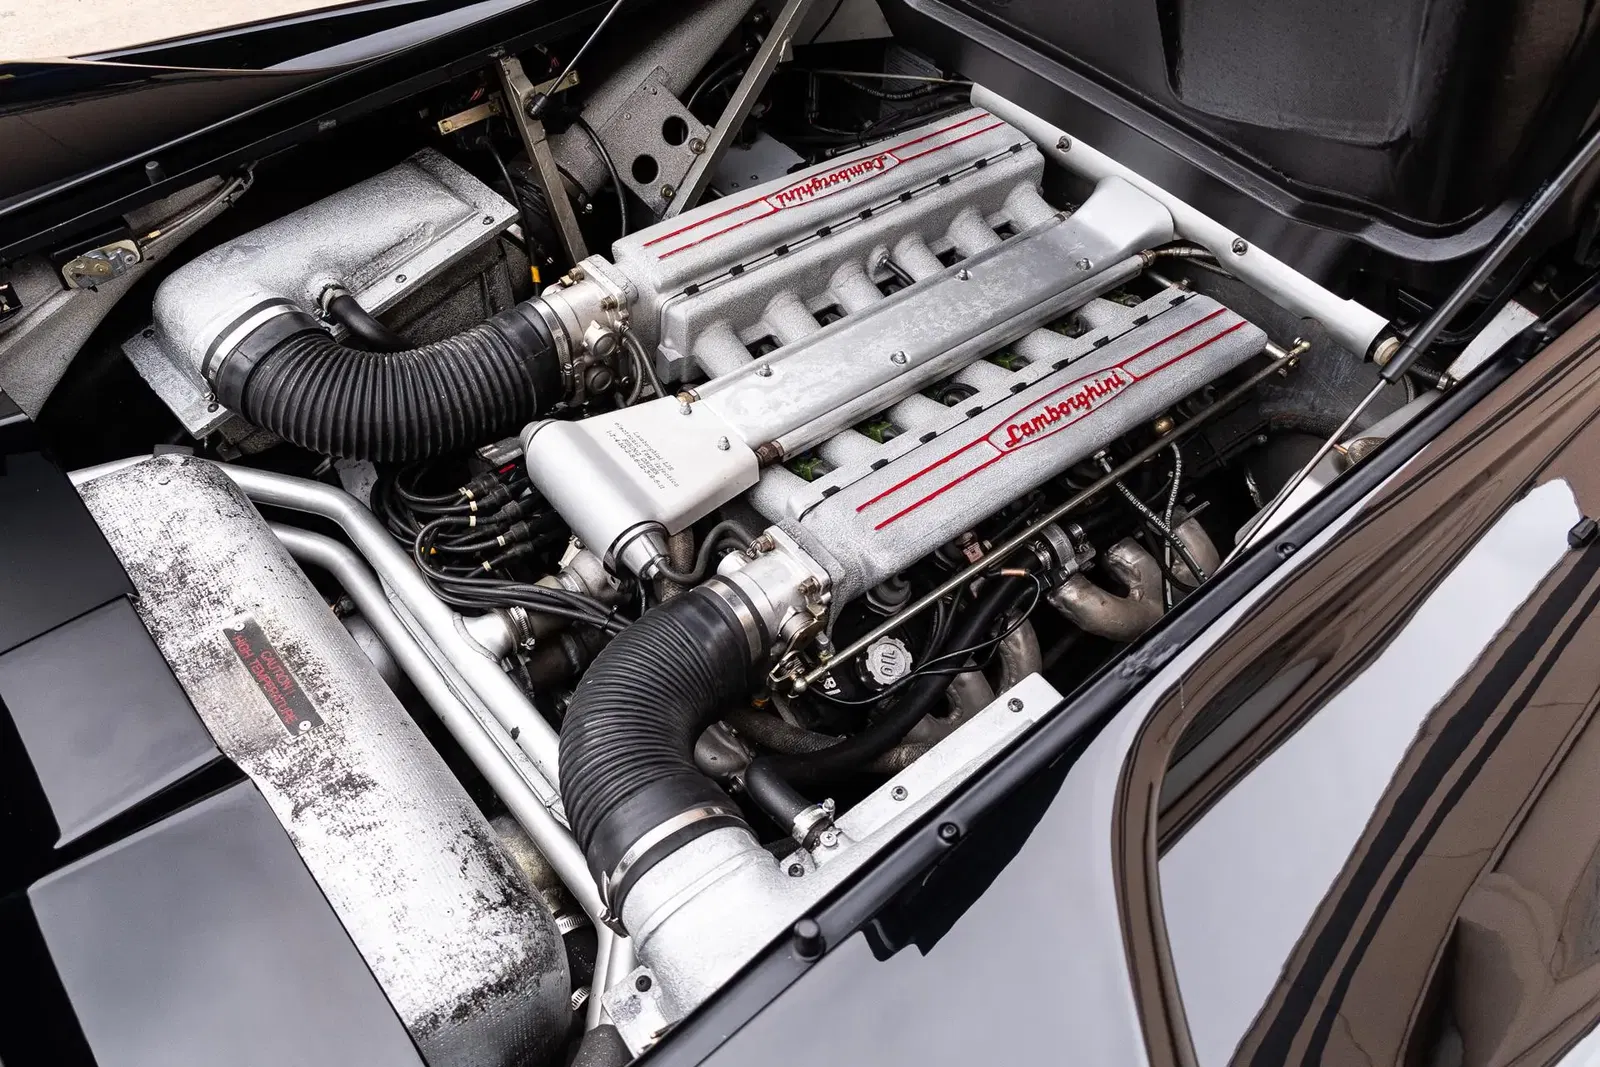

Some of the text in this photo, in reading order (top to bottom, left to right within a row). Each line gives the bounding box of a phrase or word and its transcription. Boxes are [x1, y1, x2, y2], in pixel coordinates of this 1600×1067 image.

[775, 155, 887, 207] Lamborghini
[1005, 371, 1126, 448] Lamborghini
[641, 449, 656, 461] fuel
[1116, 482, 1147, 513] DISTRIBUTOR
[1148, 511, 1170, 534] VACUUM
[1168, 479, 1180, 506] VACUUM
[232, 634, 300, 725] HIGH TEMPERATURE
[880, 650, 898, 677] OIL
